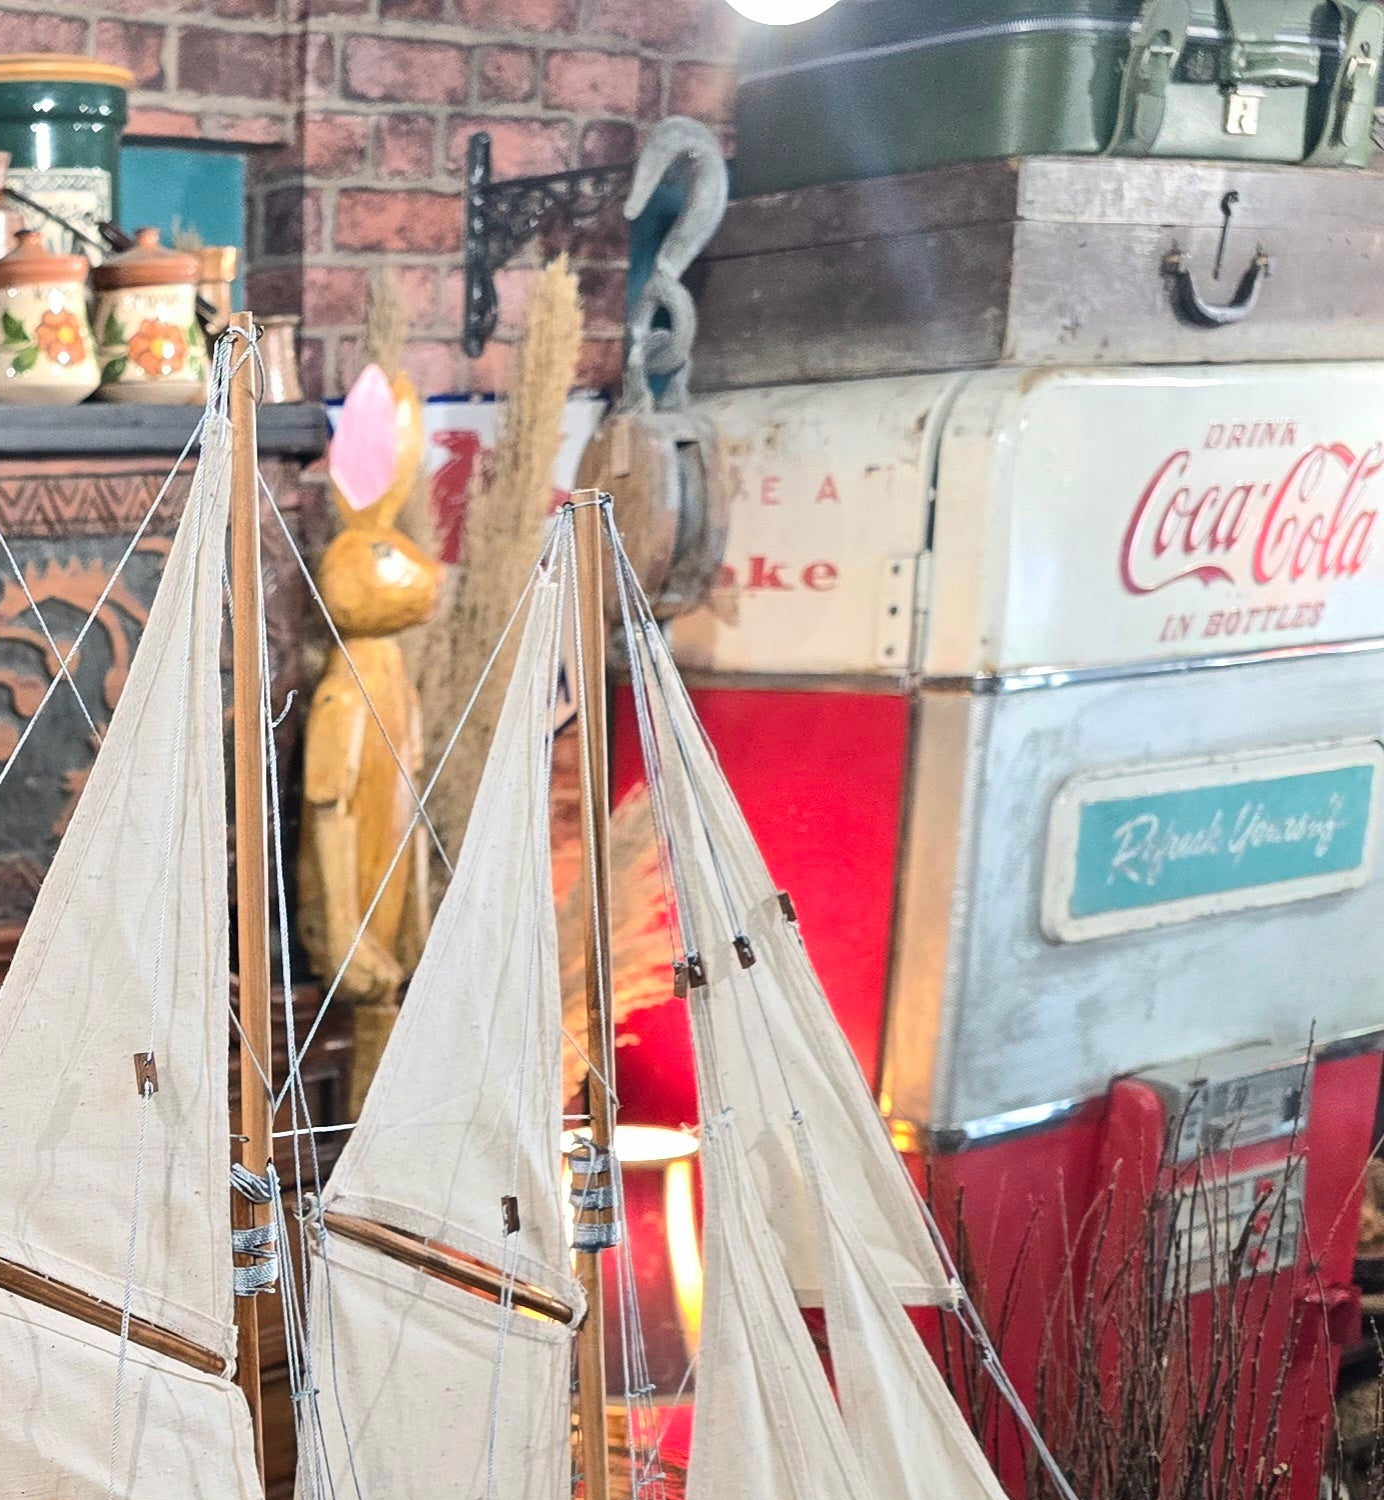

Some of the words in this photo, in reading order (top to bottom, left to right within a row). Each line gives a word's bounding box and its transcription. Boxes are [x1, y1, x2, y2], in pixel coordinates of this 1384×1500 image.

[1203, 422, 1300, 449] DRINK
[816, 473, 841, 505] A
[1159, 613, 1195, 642] IN
[1202, 602, 1325, 638] BOTTLES
